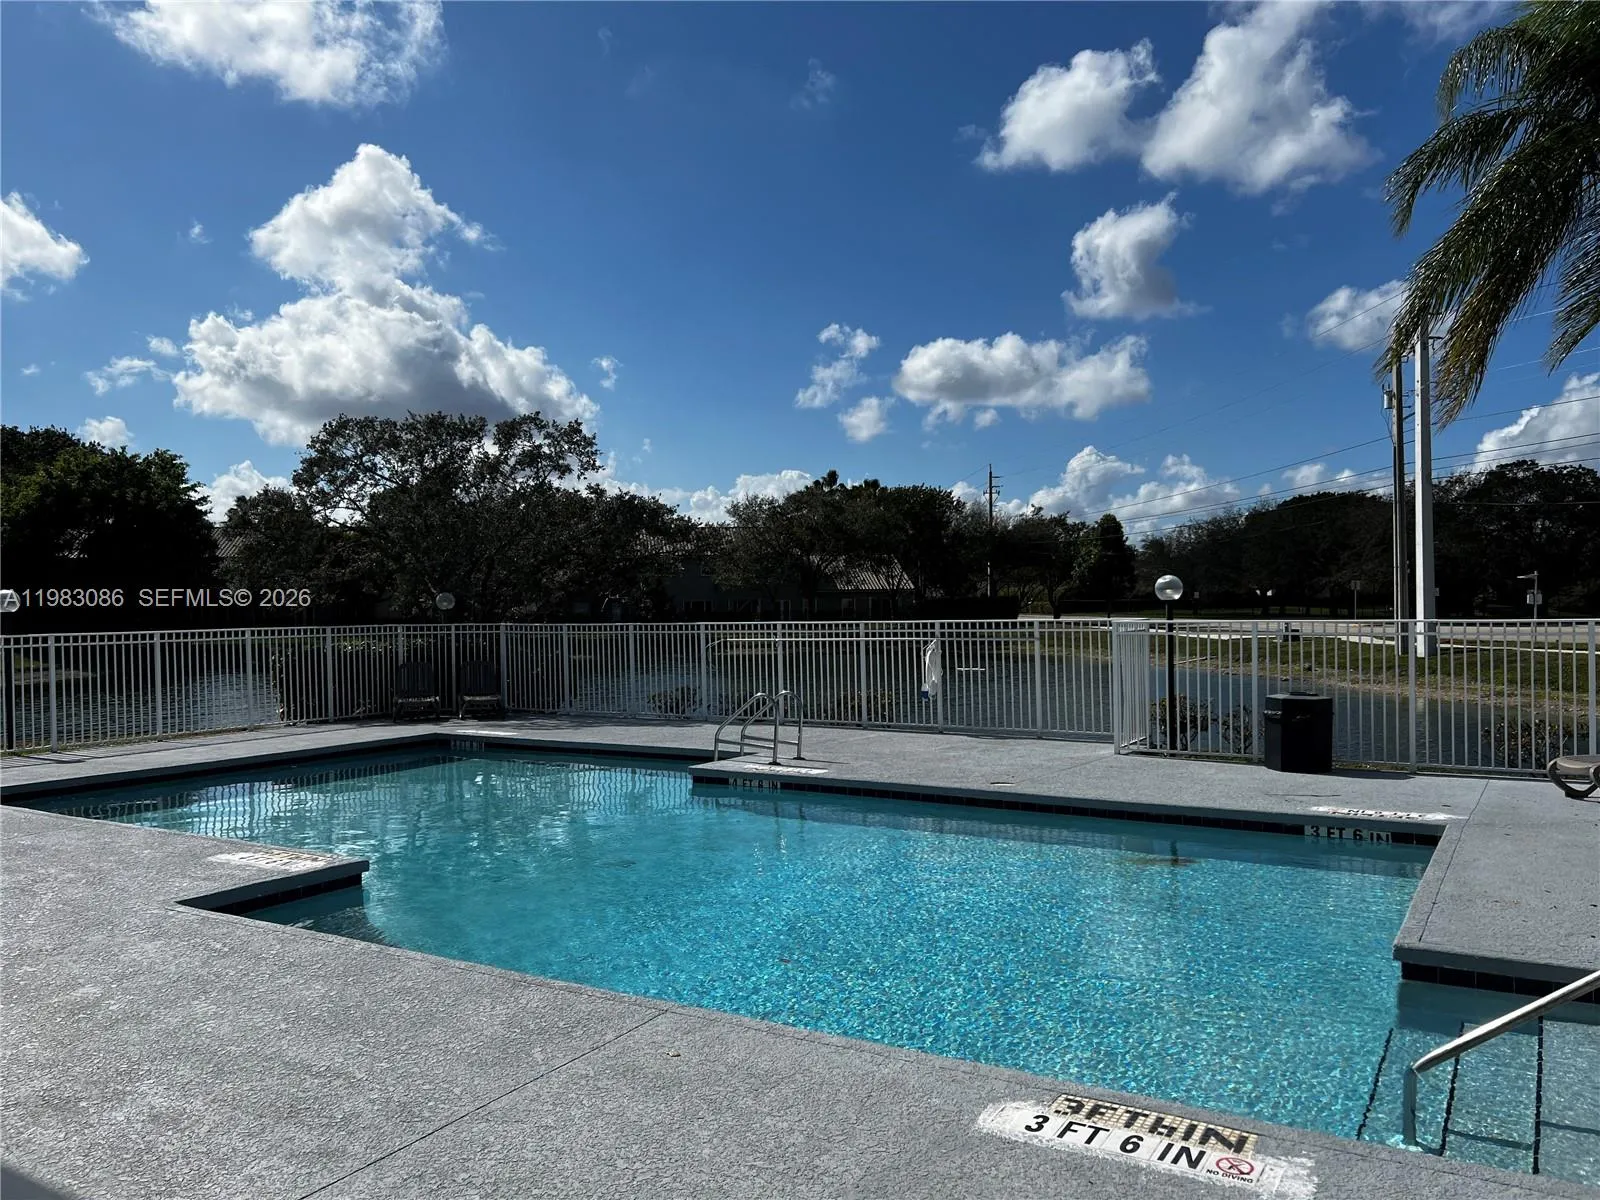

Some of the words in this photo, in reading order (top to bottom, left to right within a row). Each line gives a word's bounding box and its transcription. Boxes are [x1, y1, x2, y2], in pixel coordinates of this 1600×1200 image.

[1310, 825, 1321, 838] 3
[1353, 829, 1364, 841] 6
[1369, 832, 1390, 843] IN
[1024, 1114, 1050, 1133] 3
[1056, 1121, 1110, 1145] FT
[1119, 1134, 1144, 1154] 6
[1157, 1142, 1207, 1170] IN
[1206, 1168, 1219, 1176] NO
[1221, 1173, 1254, 1184] DIVING
